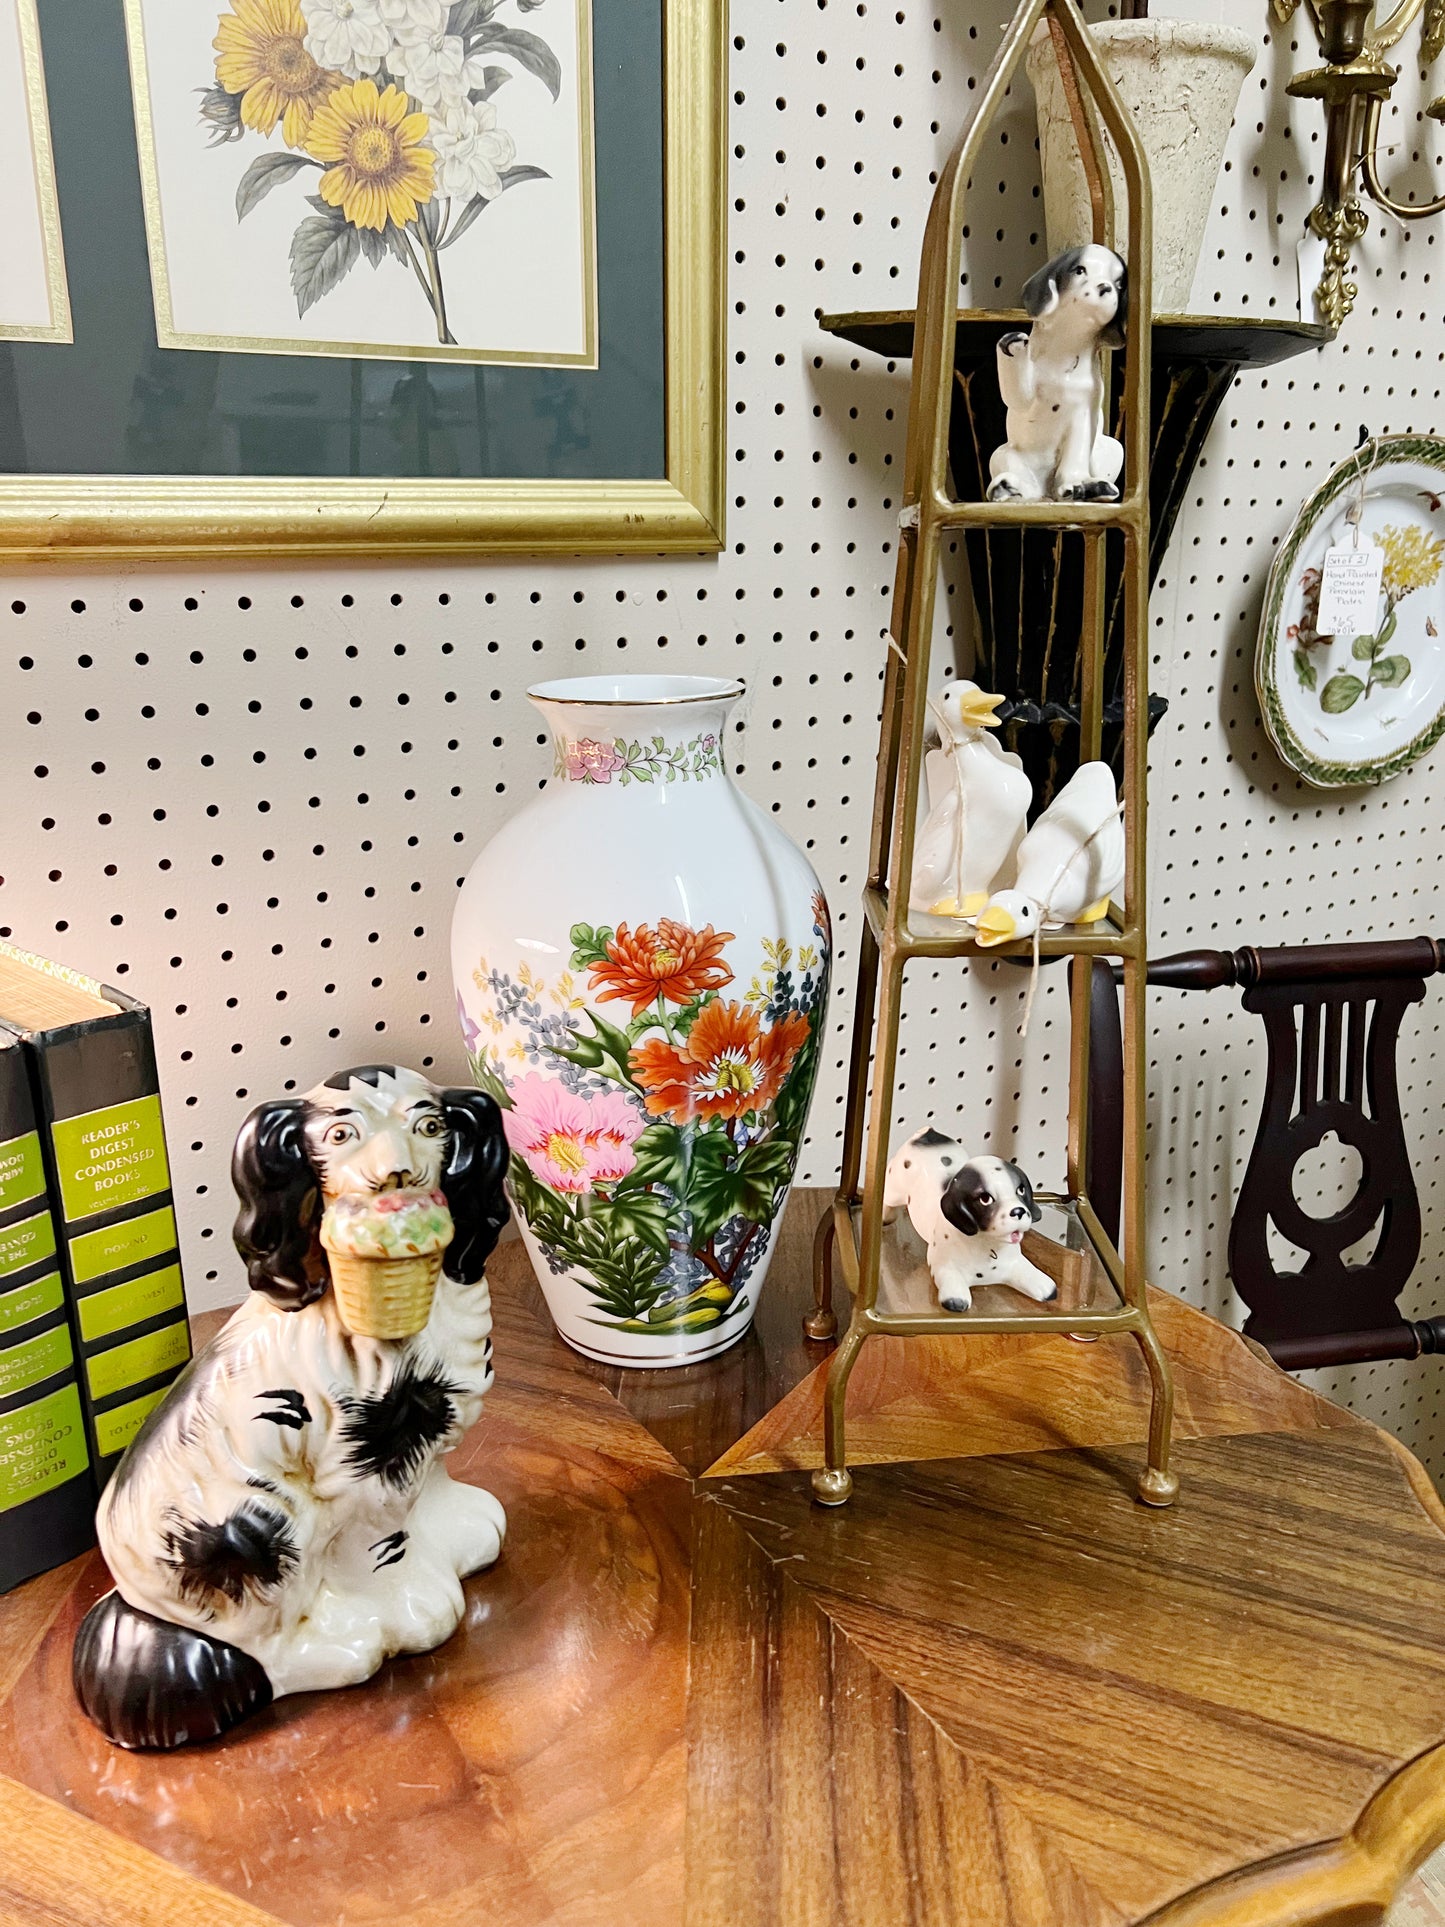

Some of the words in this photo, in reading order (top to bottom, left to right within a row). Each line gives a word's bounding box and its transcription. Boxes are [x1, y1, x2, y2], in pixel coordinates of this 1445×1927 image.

[82, 1119, 140, 1145] READER'S
[90, 1137, 135, 1159] DIGEST
[75, 1148, 154, 1181] CONDENSED
[94, 1170, 141, 1192] BOOKS
